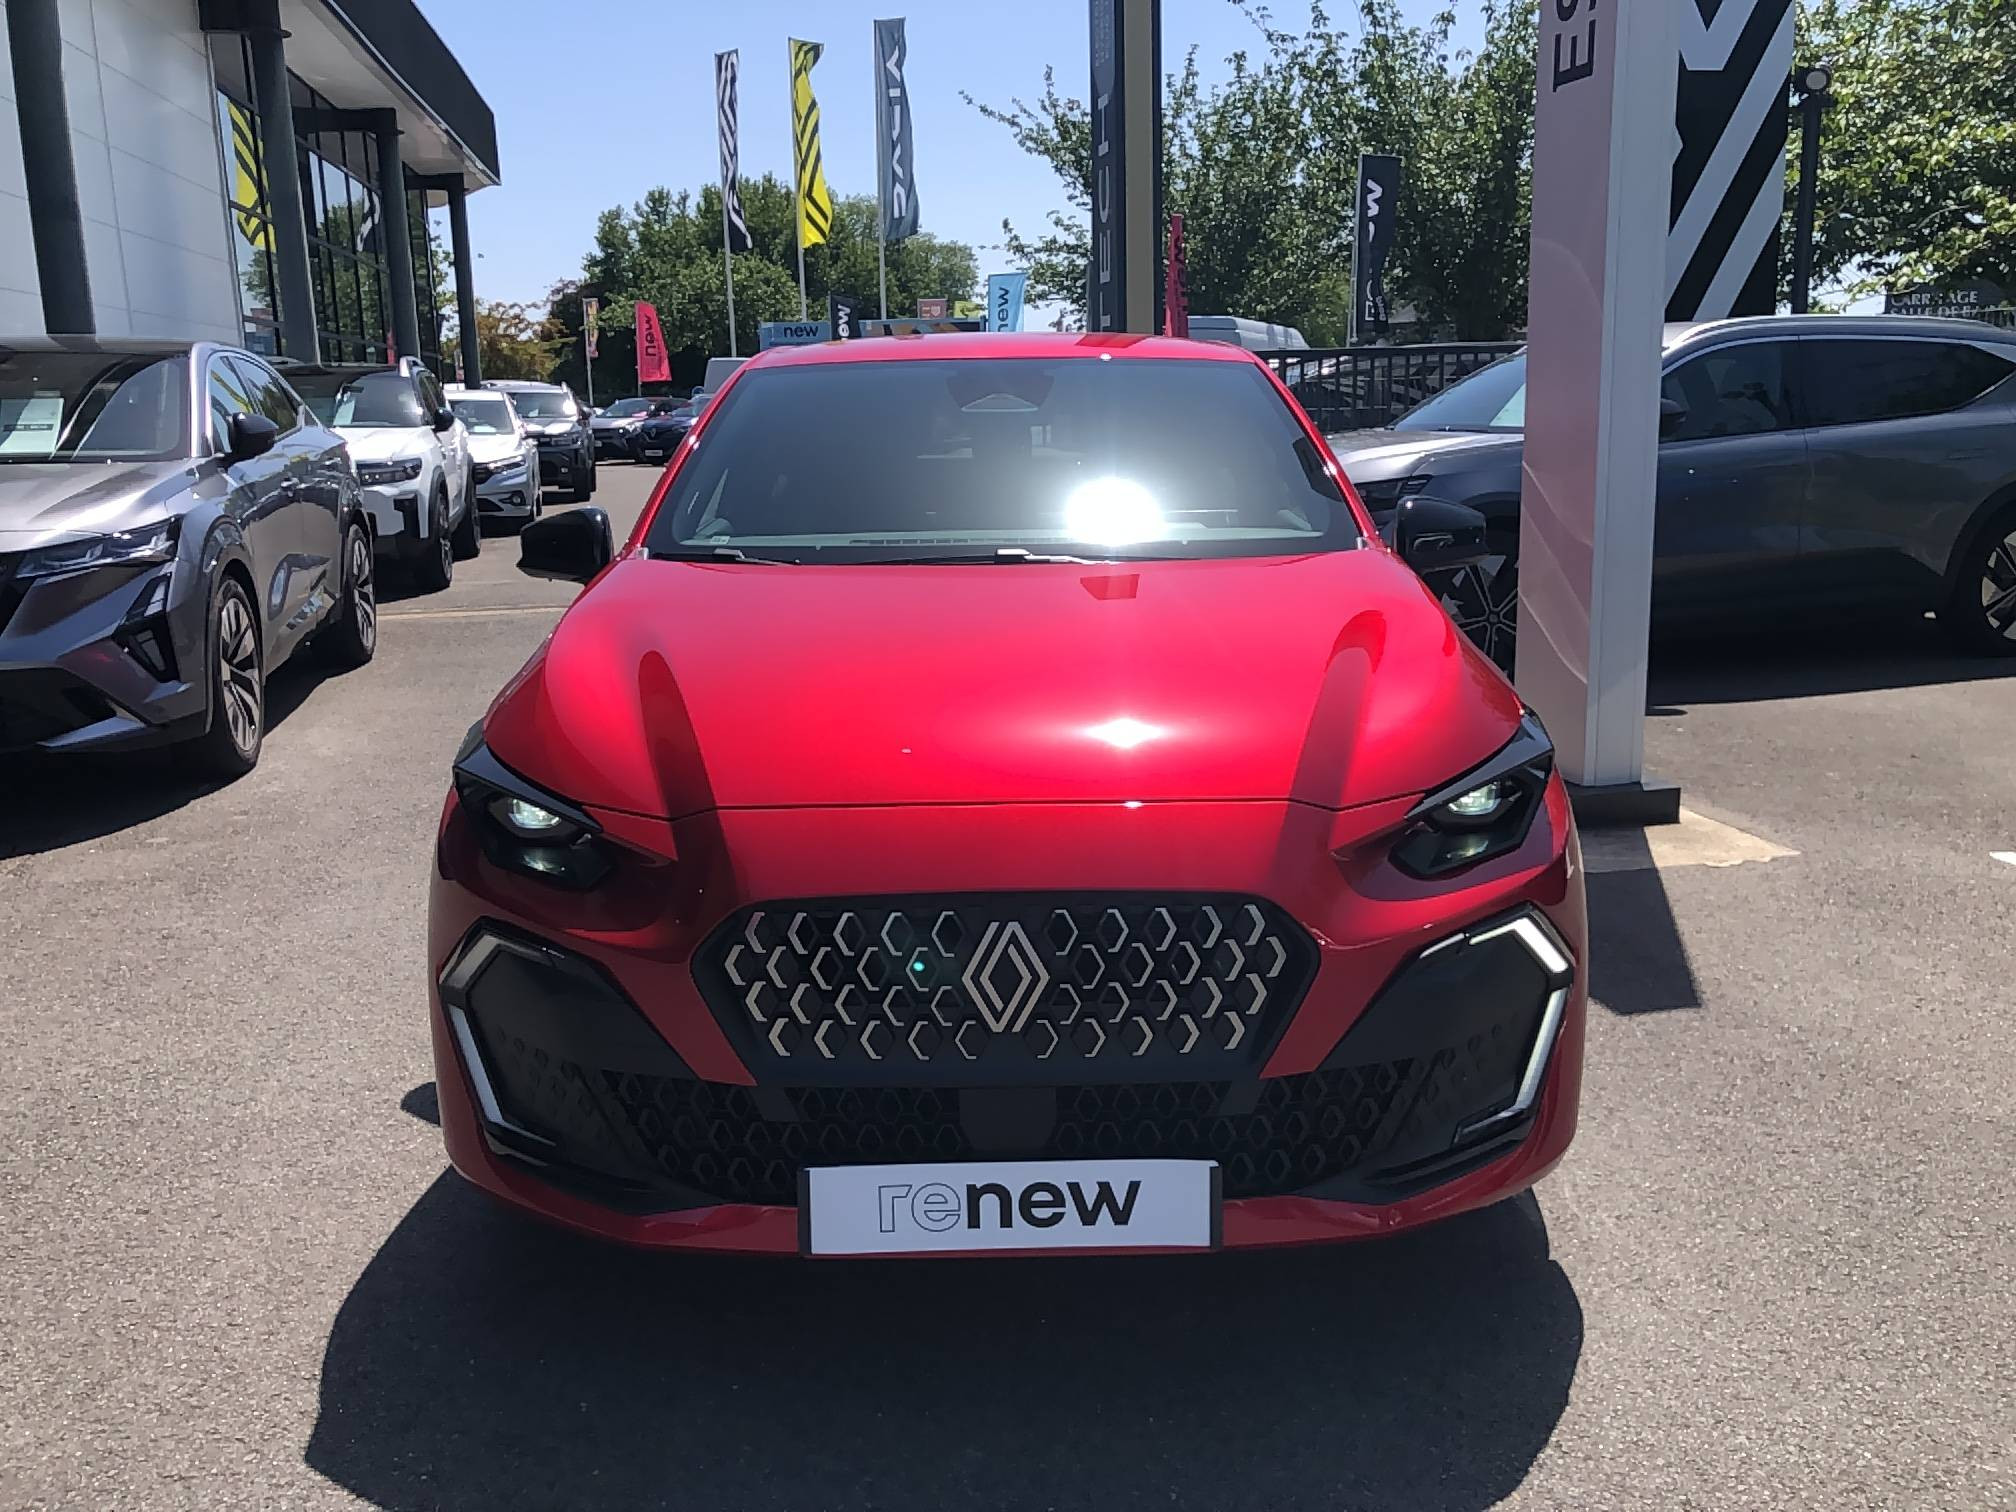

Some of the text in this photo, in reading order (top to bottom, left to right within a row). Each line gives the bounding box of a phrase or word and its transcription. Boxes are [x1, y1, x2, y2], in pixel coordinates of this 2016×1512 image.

[837, 304, 851, 341] ew
[997, 287, 1010, 332] new
[783, 325, 819, 338] new
[878, 1180, 1142, 1233] renew
